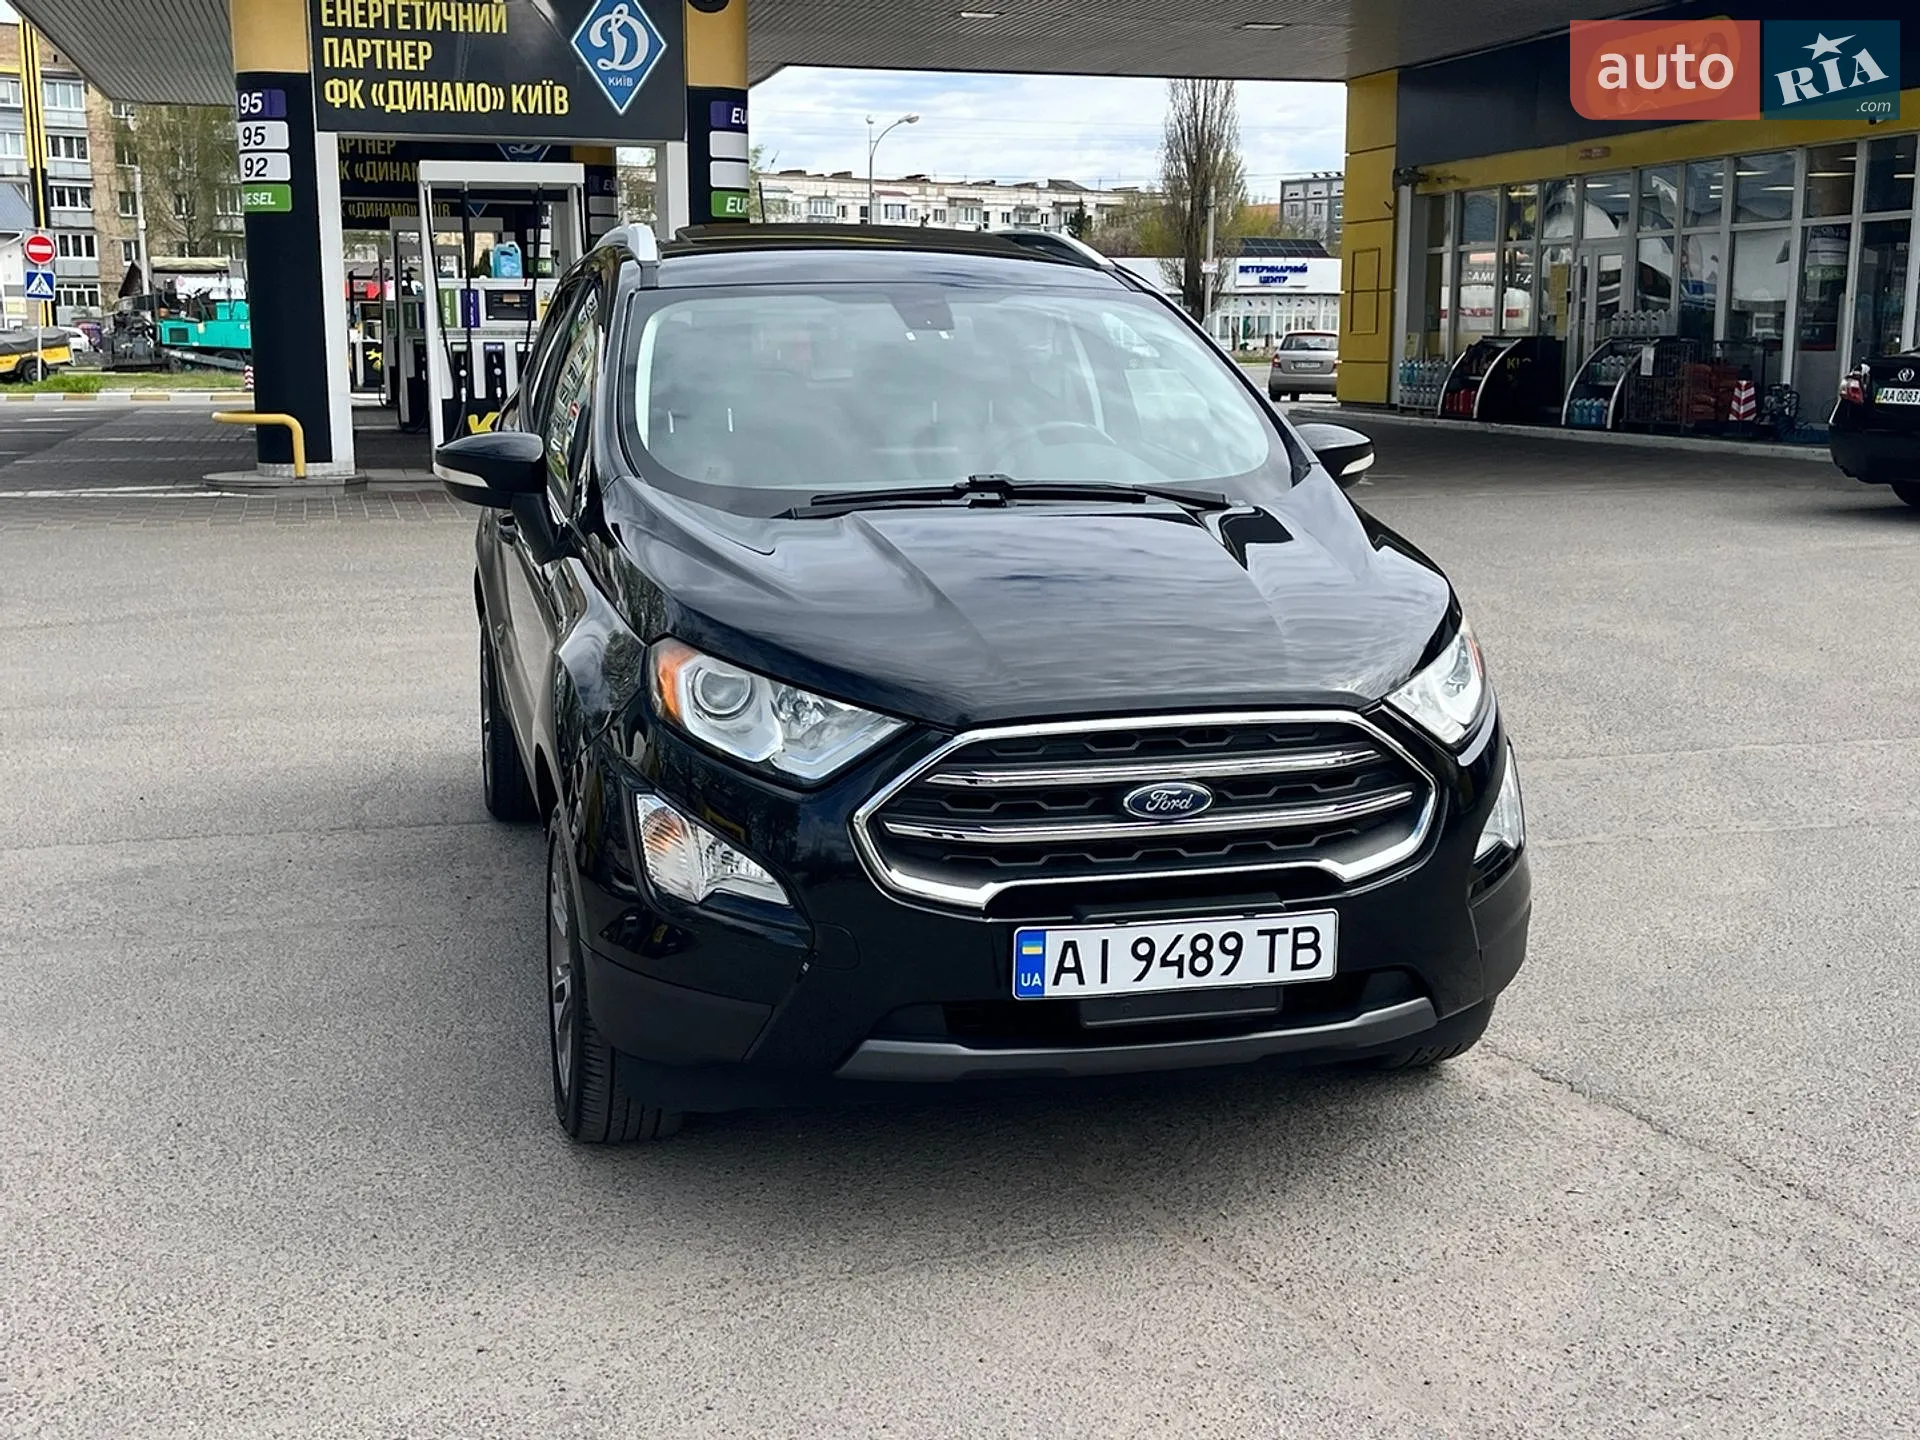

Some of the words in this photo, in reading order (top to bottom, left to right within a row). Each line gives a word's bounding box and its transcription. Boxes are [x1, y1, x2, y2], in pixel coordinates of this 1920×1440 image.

[321, 0, 508, 34] ЕНЕРГЕТИЧНИЙ
[322, 37, 433, 71] ПАРТНЕР
[608, 76, 633, 87] КИЇВ
[240, 92, 263, 114] 95
[324, 78, 365, 109] ФК
[371, 80, 505, 113] «ДИНАМО»
[511, 80, 570, 115] КИЇВ
[242, 126, 266, 147] 95
[244, 157, 268, 178] 92
[243, 192, 276, 206] ESEL
[1259, 275, 1288, 284] ЦЕНТР
[1145, 789, 1194, 812] Ford
[1052, 938, 1110, 986] AI
[1130, 931, 1244, 982] 9489
[1257, 926, 1323, 973] TB
[1021, 973, 1042, 986] UA
